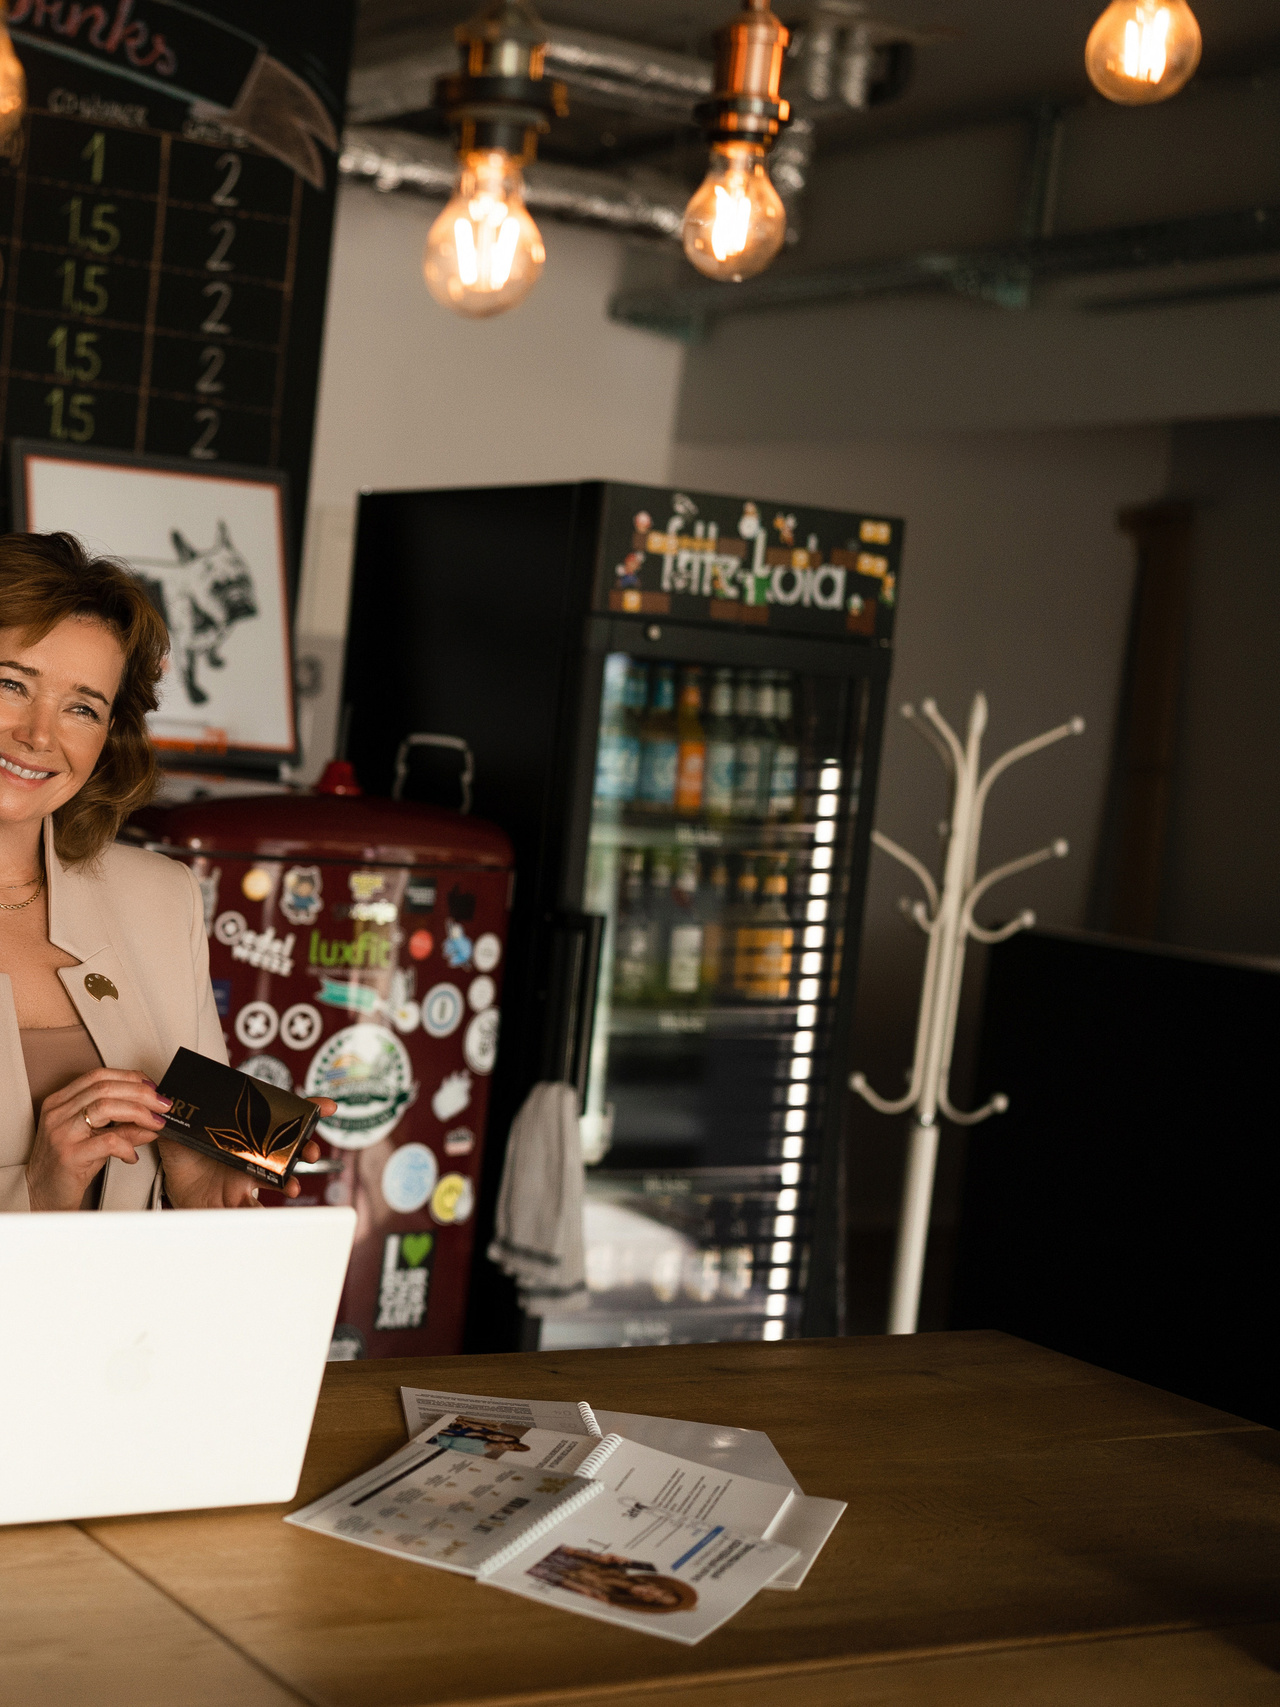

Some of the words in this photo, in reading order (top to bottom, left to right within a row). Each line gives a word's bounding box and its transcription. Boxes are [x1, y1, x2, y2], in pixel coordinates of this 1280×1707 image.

[81, 131, 106, 184] 1
[211, 152, 242, 207] 2
[206, 220, 236, 271] 2
[200, 281, 232, 334] 2
[196, 346, 226, 393] 2
[190, 408, 220, 460] 2
[309, 929, 392, 968] luxfit
[162, 1093, 200, 1120] RT
